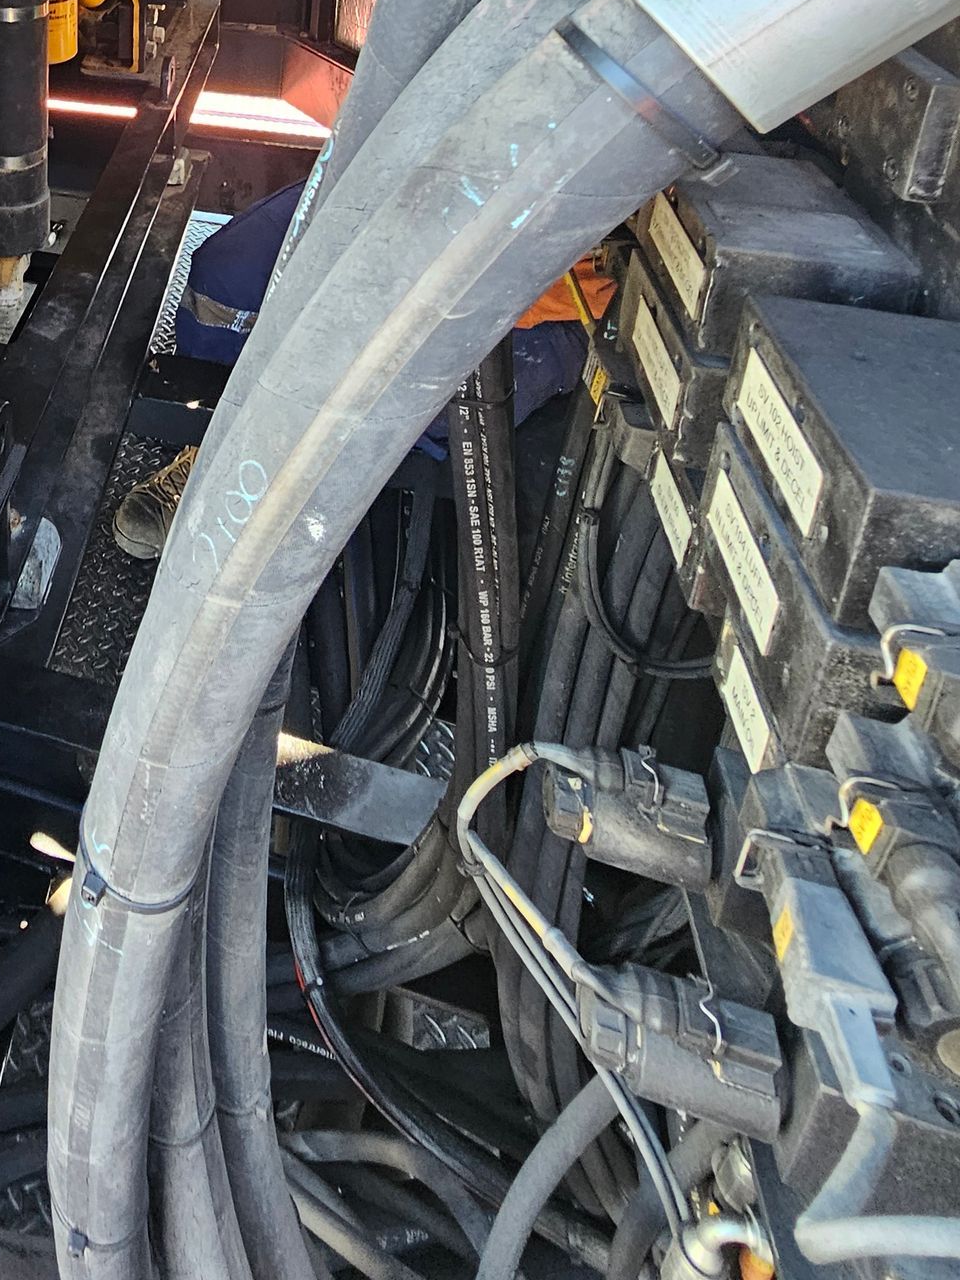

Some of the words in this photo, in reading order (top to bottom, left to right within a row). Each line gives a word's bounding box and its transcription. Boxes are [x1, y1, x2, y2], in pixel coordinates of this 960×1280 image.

[462, 440, 473, 457] EN
[781, 423, 806, 471] HOIST
[464, 457, 475, 479] 853
[756, 411, 775, 449] LIMIT
[781, 458, 806, 513] DECEL
[466, 478, 477, 499] 1SN
[469, 505, 480, 529] SAE
[471, 528, 482, 549] 100
[473, 548, 486, 572] R1AT
[478, 590, 489, 608] WP
[481, 624, 493, 645] BAR
